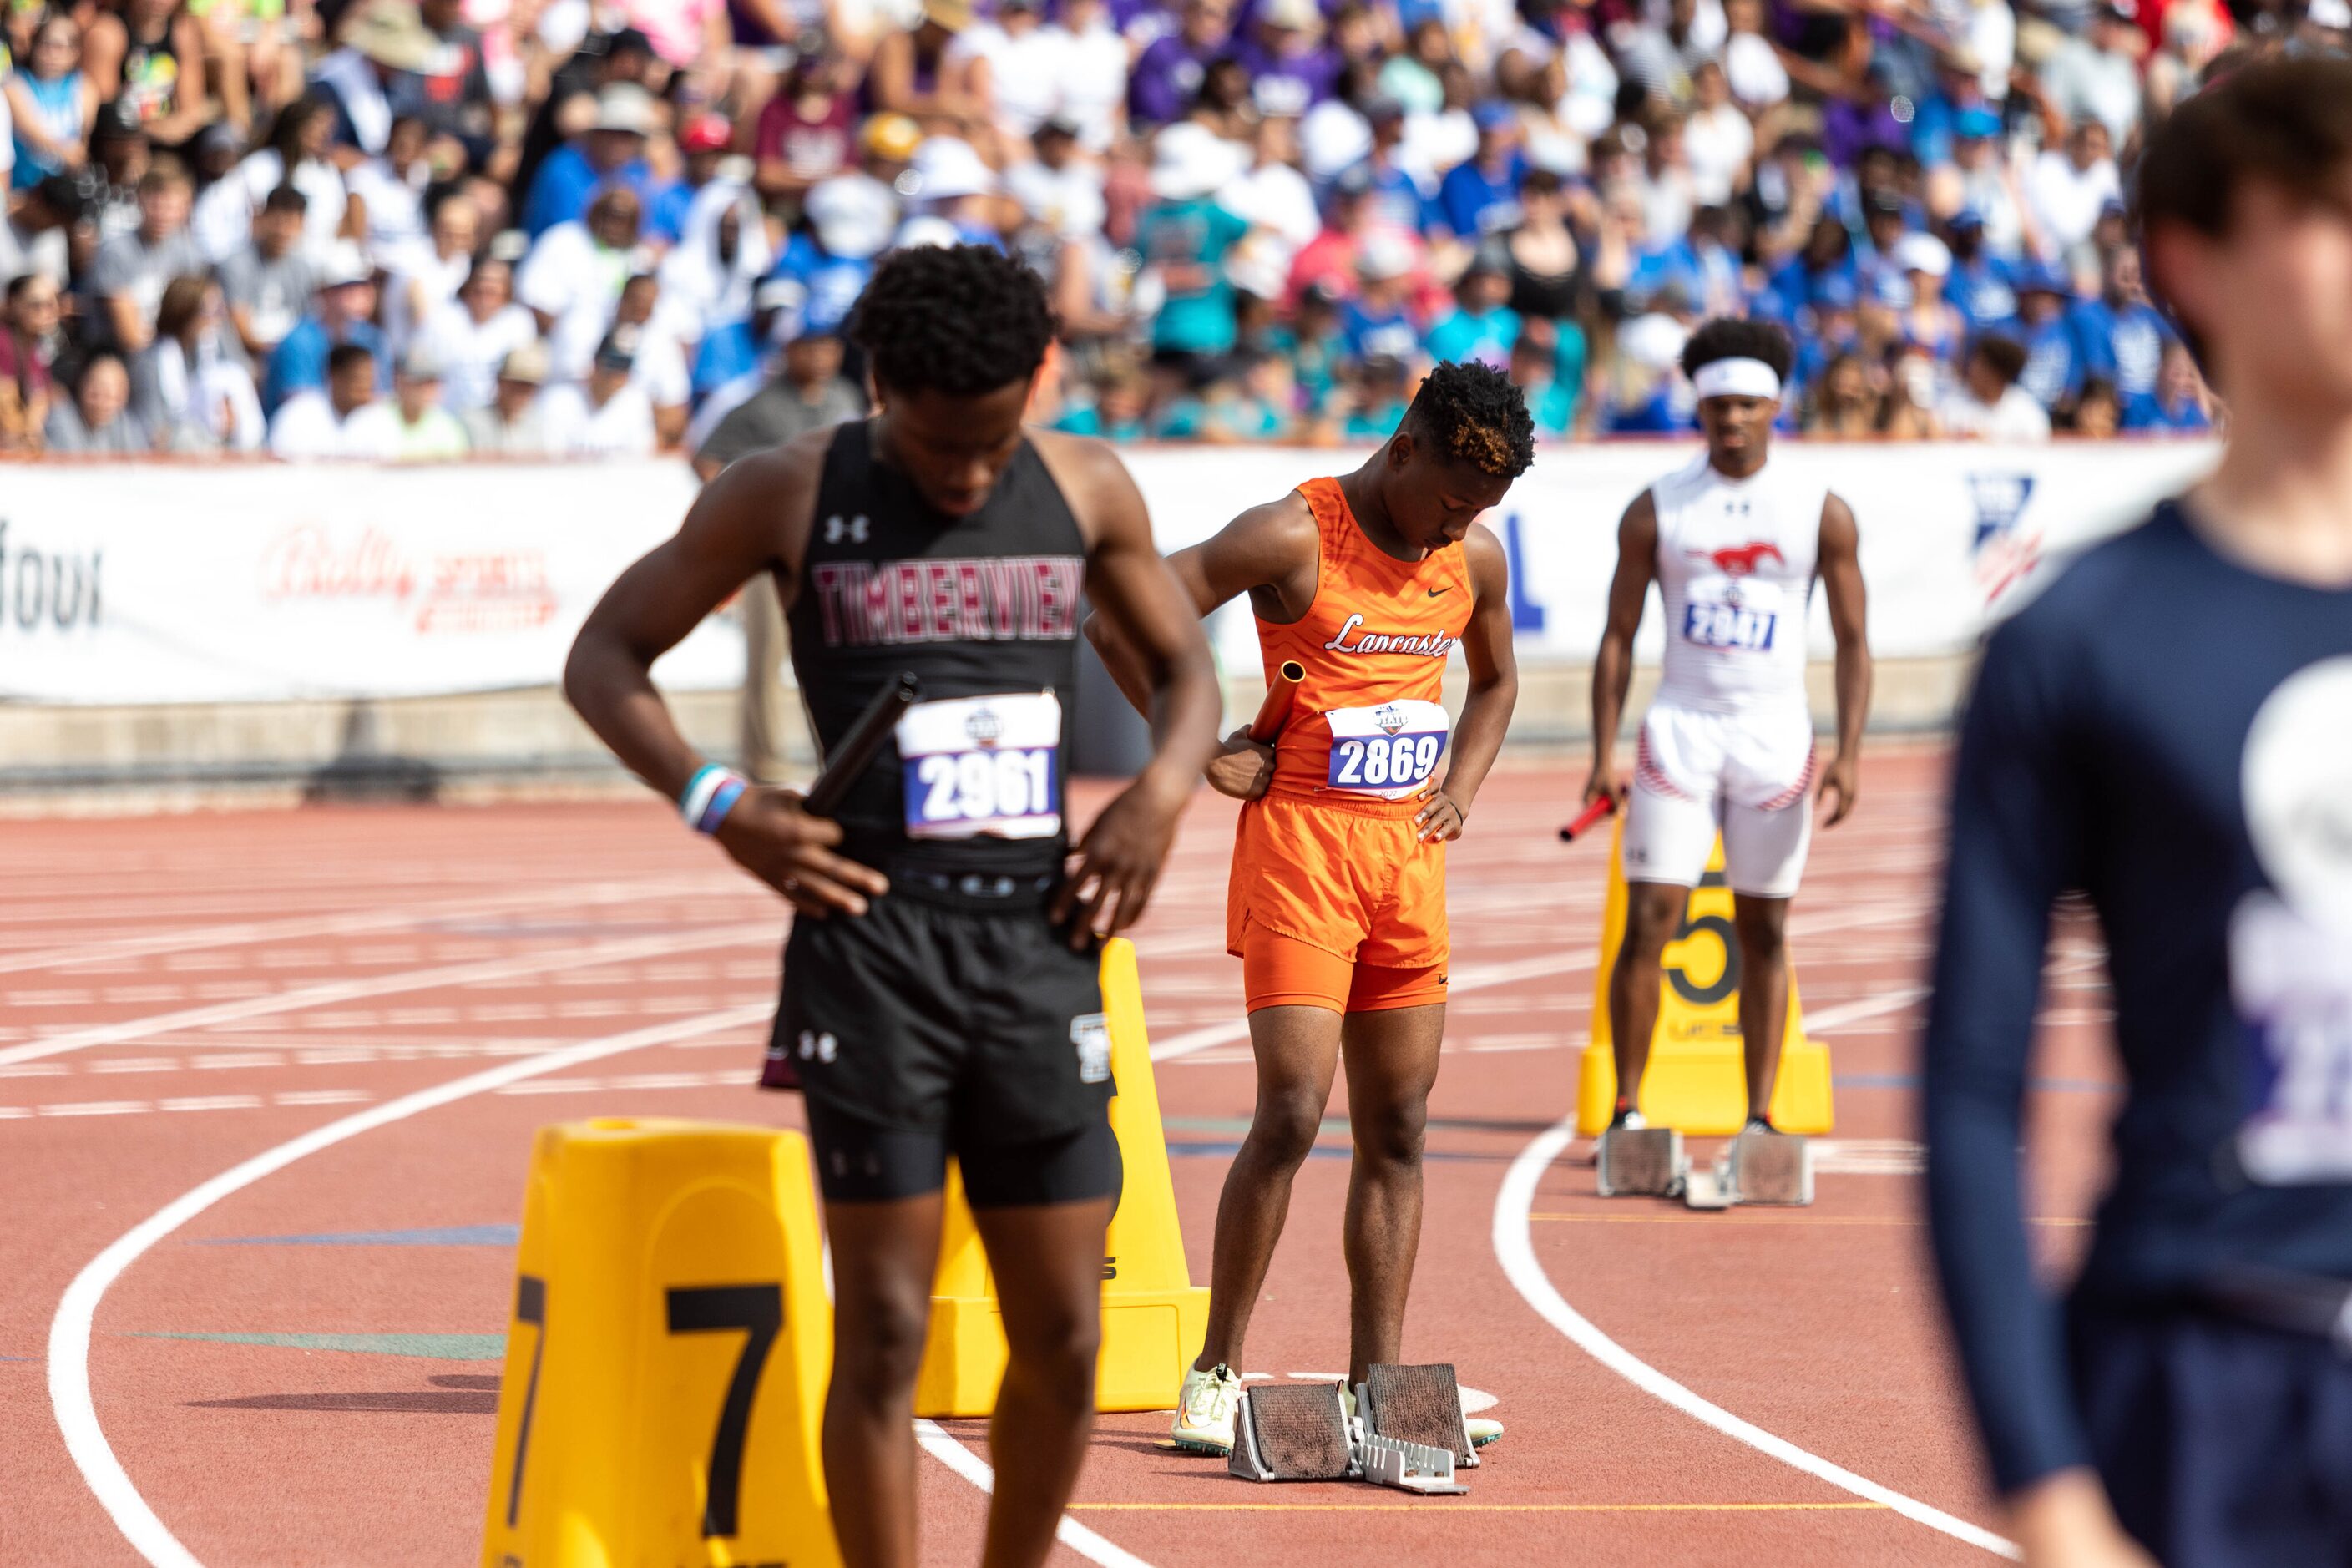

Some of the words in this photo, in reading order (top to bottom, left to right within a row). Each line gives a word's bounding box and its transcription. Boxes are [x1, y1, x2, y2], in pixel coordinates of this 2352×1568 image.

[919, 748, 1049, 822] 2961
[1338, 736, 1439, 785] 2869
[1378, 790, 1398, 798] 2022
[665, 1282, 784, 1540] 7
